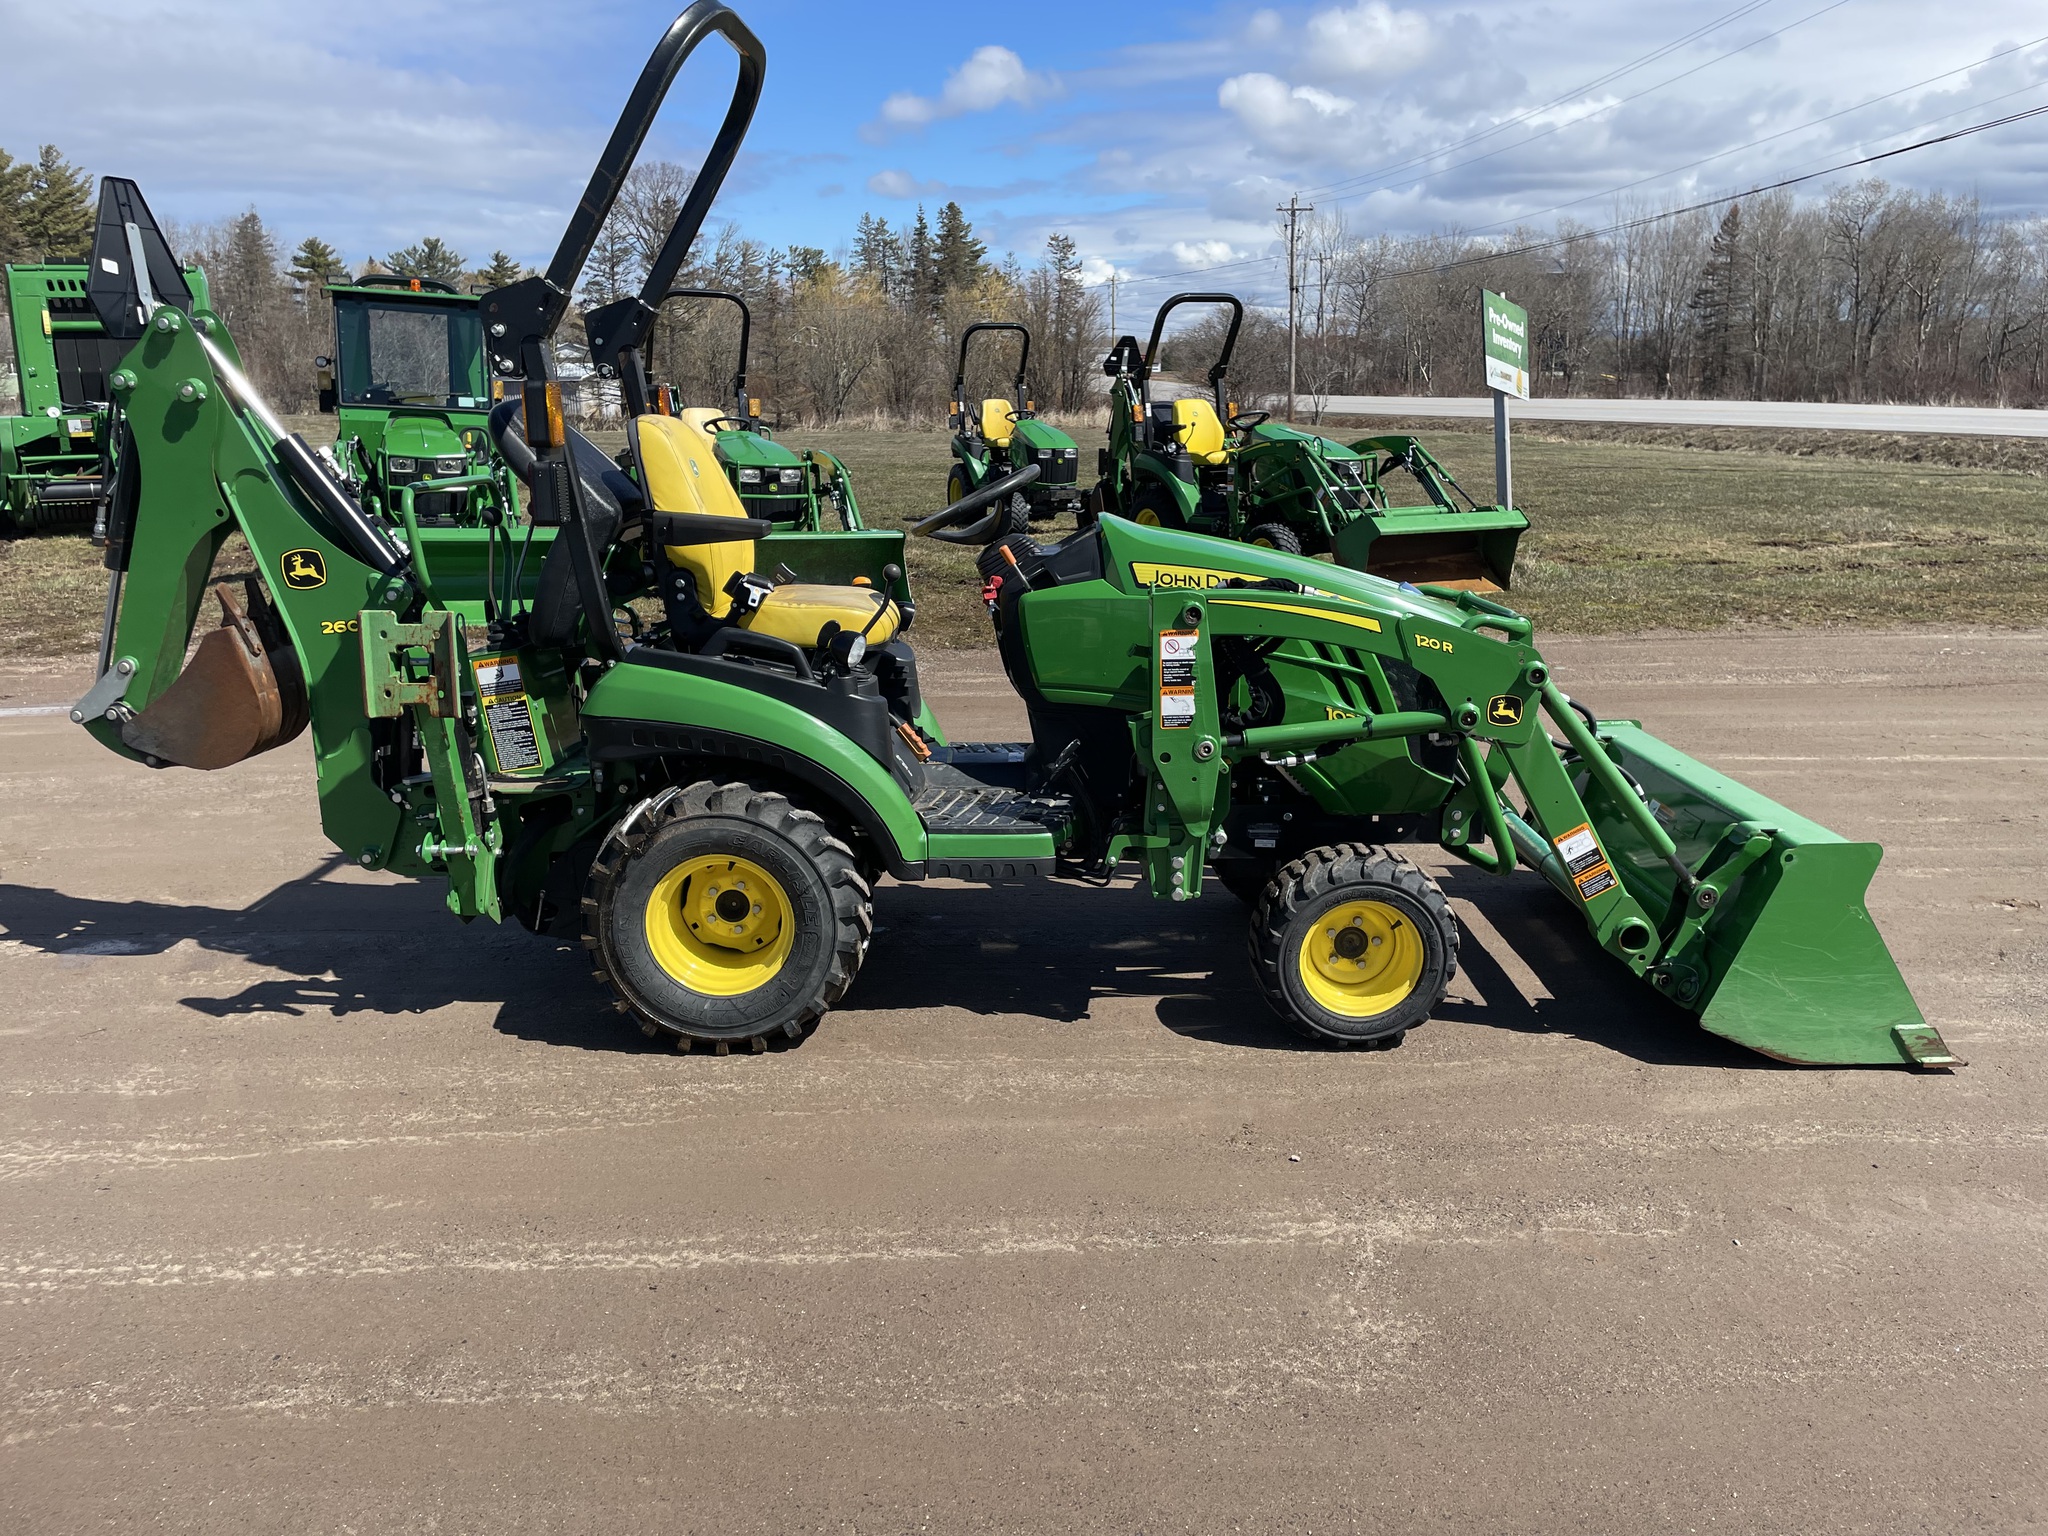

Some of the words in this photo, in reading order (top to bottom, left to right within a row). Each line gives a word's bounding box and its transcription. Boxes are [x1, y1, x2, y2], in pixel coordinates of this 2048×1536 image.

[1488, 306, 1524, 338] Pre-Owned
[1492, 327, 1522, 360] Inventory
[1153, 570, 1201, 588] JOHN
[483, 658, 514, 667] WARNING
[494, 695, 521, 704] CAUTION
[1562, 826, 1585, 840] WARNING
[728, 833, 819, 926] CARLISLE
[1584, 866, 1606, 879] WARNING
